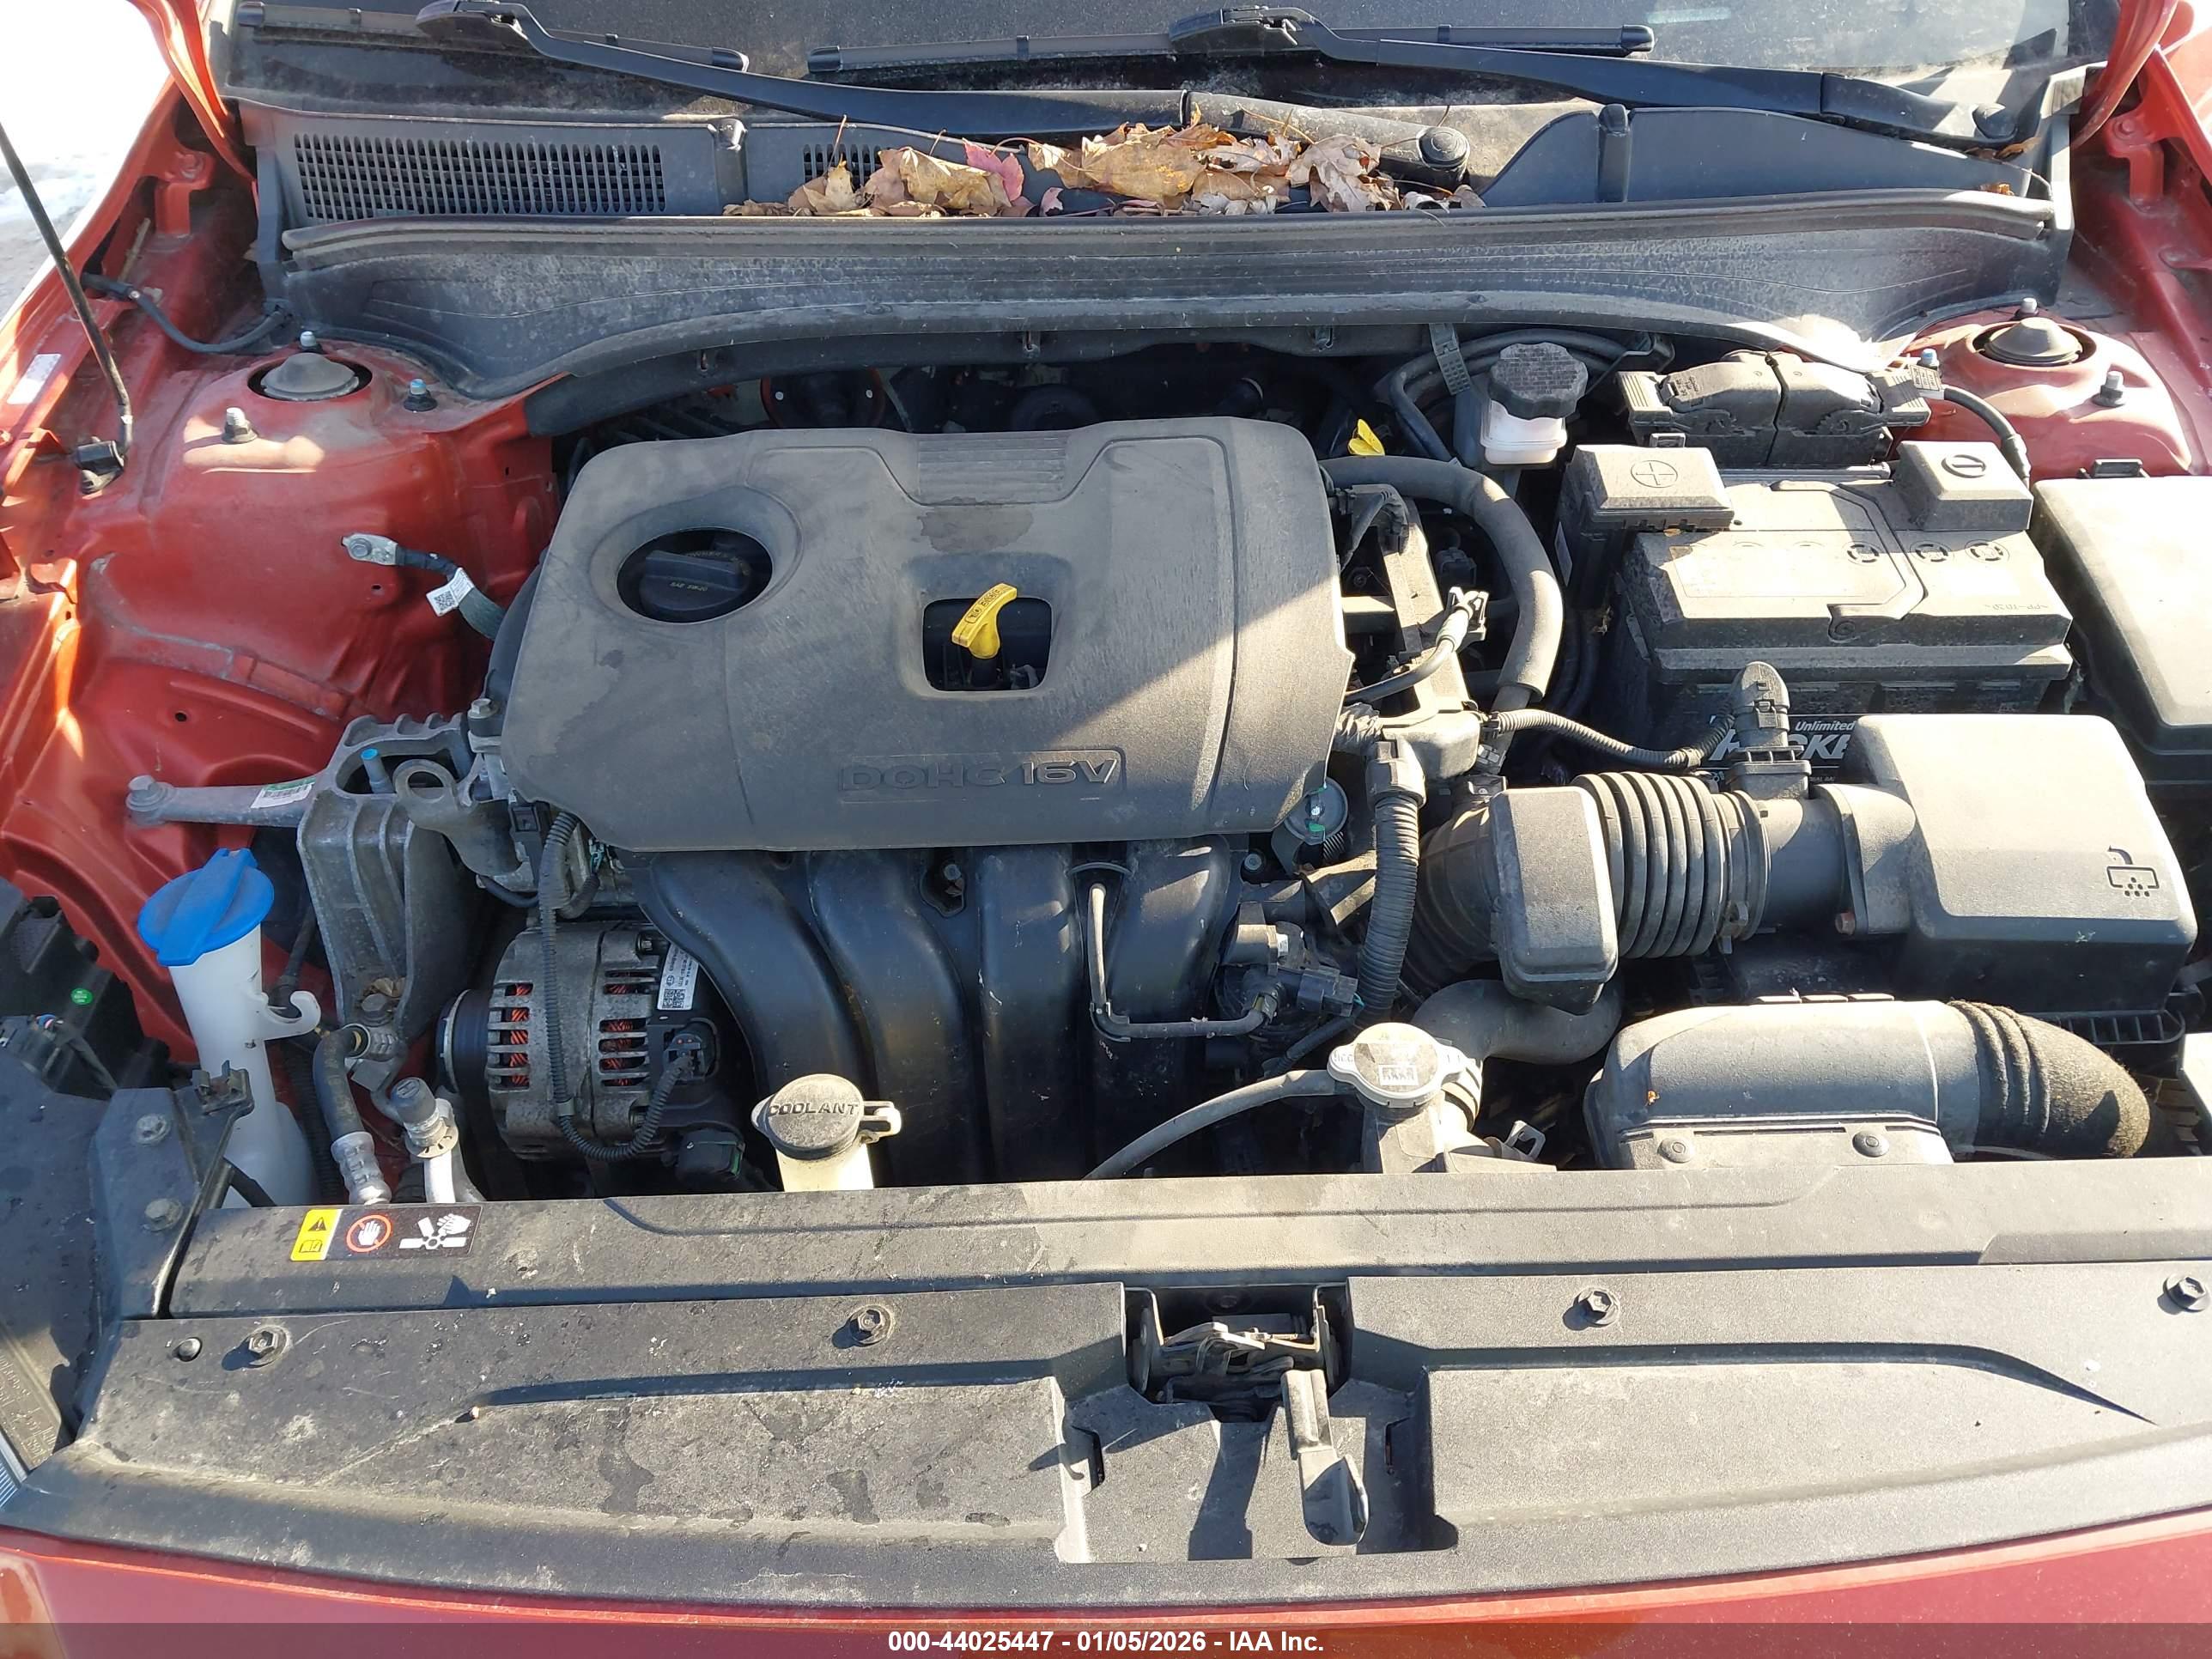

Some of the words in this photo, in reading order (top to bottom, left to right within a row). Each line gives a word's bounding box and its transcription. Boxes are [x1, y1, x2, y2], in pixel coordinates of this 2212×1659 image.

[1795, 720, 1856, 732] Unlimited
[840, 762, 1006, 791] DOHC
[1022, 759, 1117, 785] 16V
[769, 1101, 859, 1116] COOLANT
